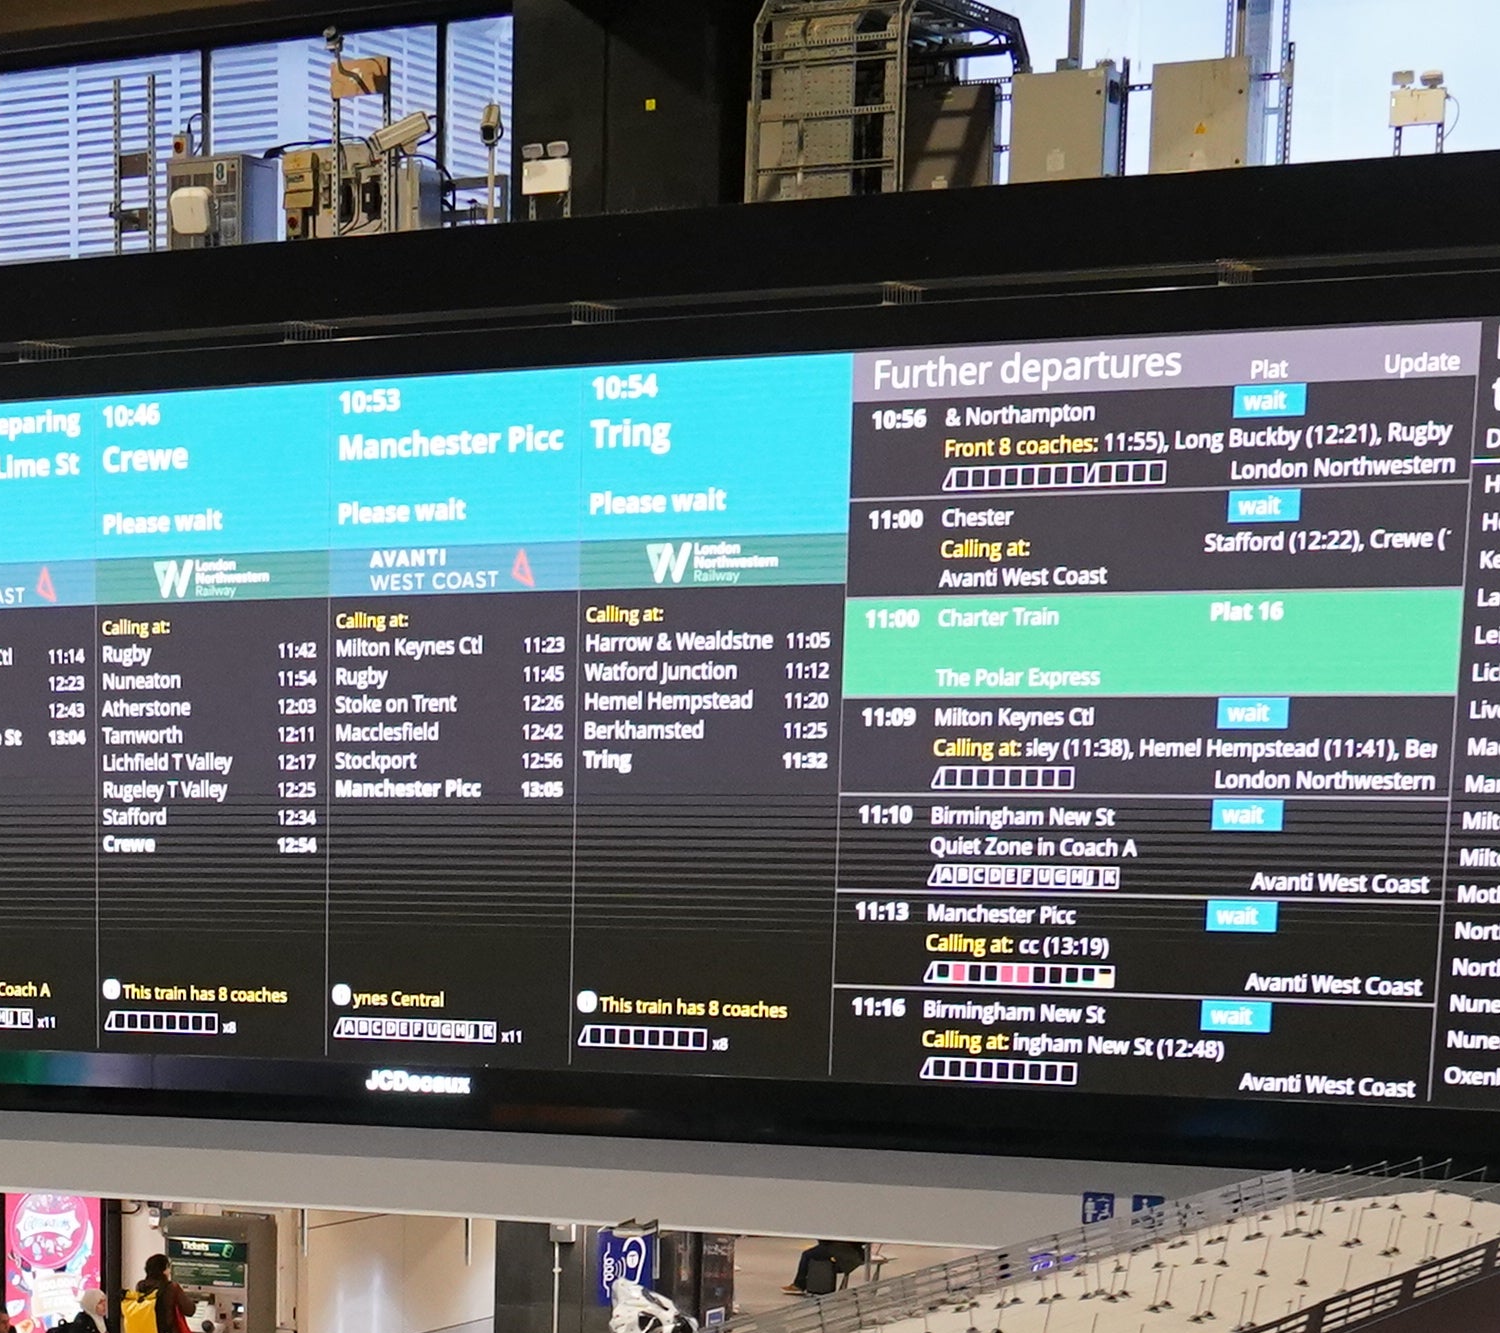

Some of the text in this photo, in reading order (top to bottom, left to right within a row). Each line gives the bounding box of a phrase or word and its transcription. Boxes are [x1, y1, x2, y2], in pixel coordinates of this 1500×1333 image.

[873, 350, 1181, 391] Further departures
[591, 374, 658, 400] 10:54
[339, 389, 400, 414] 10:53
[102, 404, 160, 429] 10:46
[872, 403, 1096, 430] 10:56 & Northampton
[339, 425, 564, 461] Manchester Picc
[590, 418, 672, 454] Tring
[102, 445, 189, 473] Crewe
[1231, 455, 1456, 480] London Northwestern
[941, 508, 1014, 529] Chester
[938, 602, 1283, 629] Charter Train Plat 16
[102, 642, 317, 667] Rugby 11:42
[102, 670, 317, 691] Nuneaton 11:54
[936, 667, 1101, 691] The Polar Express
[101, 697, 317, 718] Atherstone 12:03
[365, 1070, 470, 1093] JCDecaux
